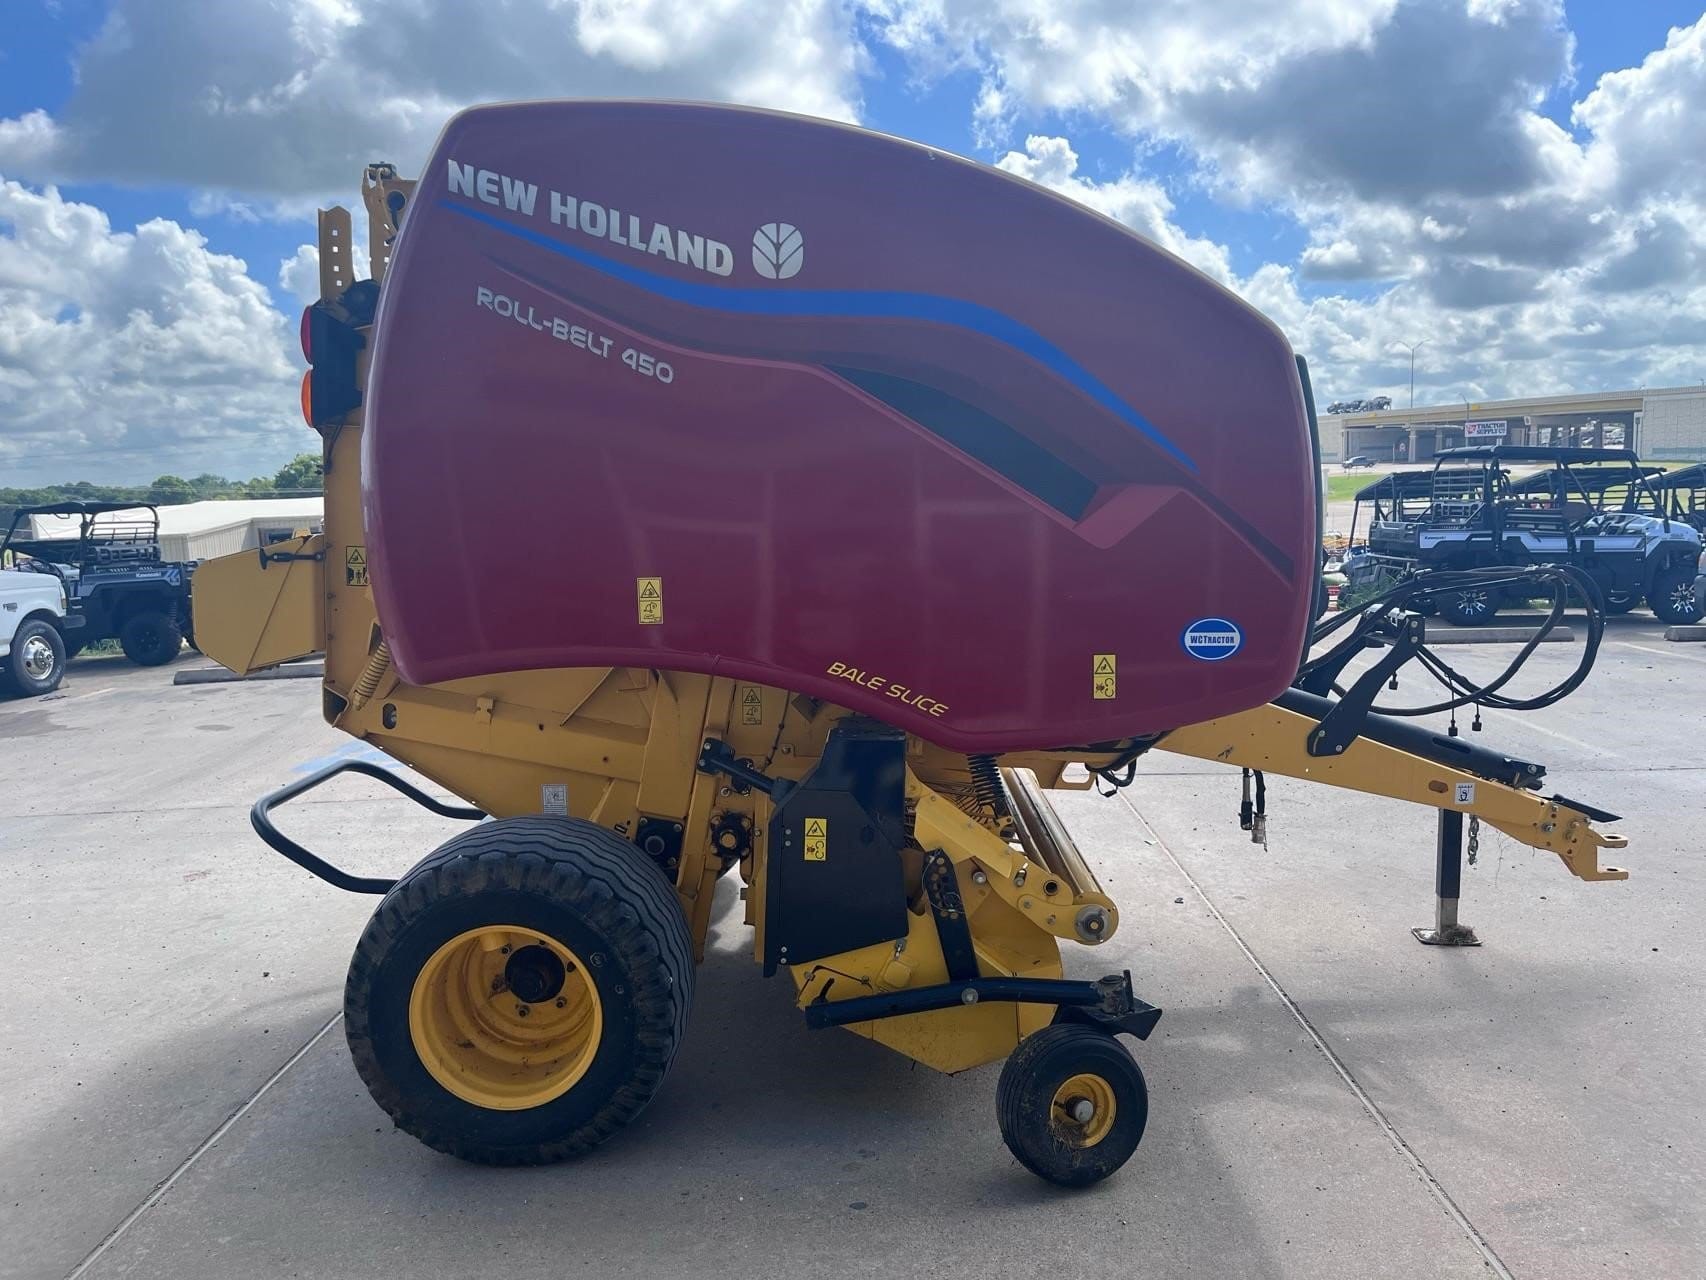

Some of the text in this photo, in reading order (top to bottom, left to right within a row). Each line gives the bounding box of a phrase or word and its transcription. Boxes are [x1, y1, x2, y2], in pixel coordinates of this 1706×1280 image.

[448, 159, 734, 277] NEW HOLLAND
[476, 286, 674, 384] ROLL-BELT 450
[826, 661, 949, 717] BALE SLICE
